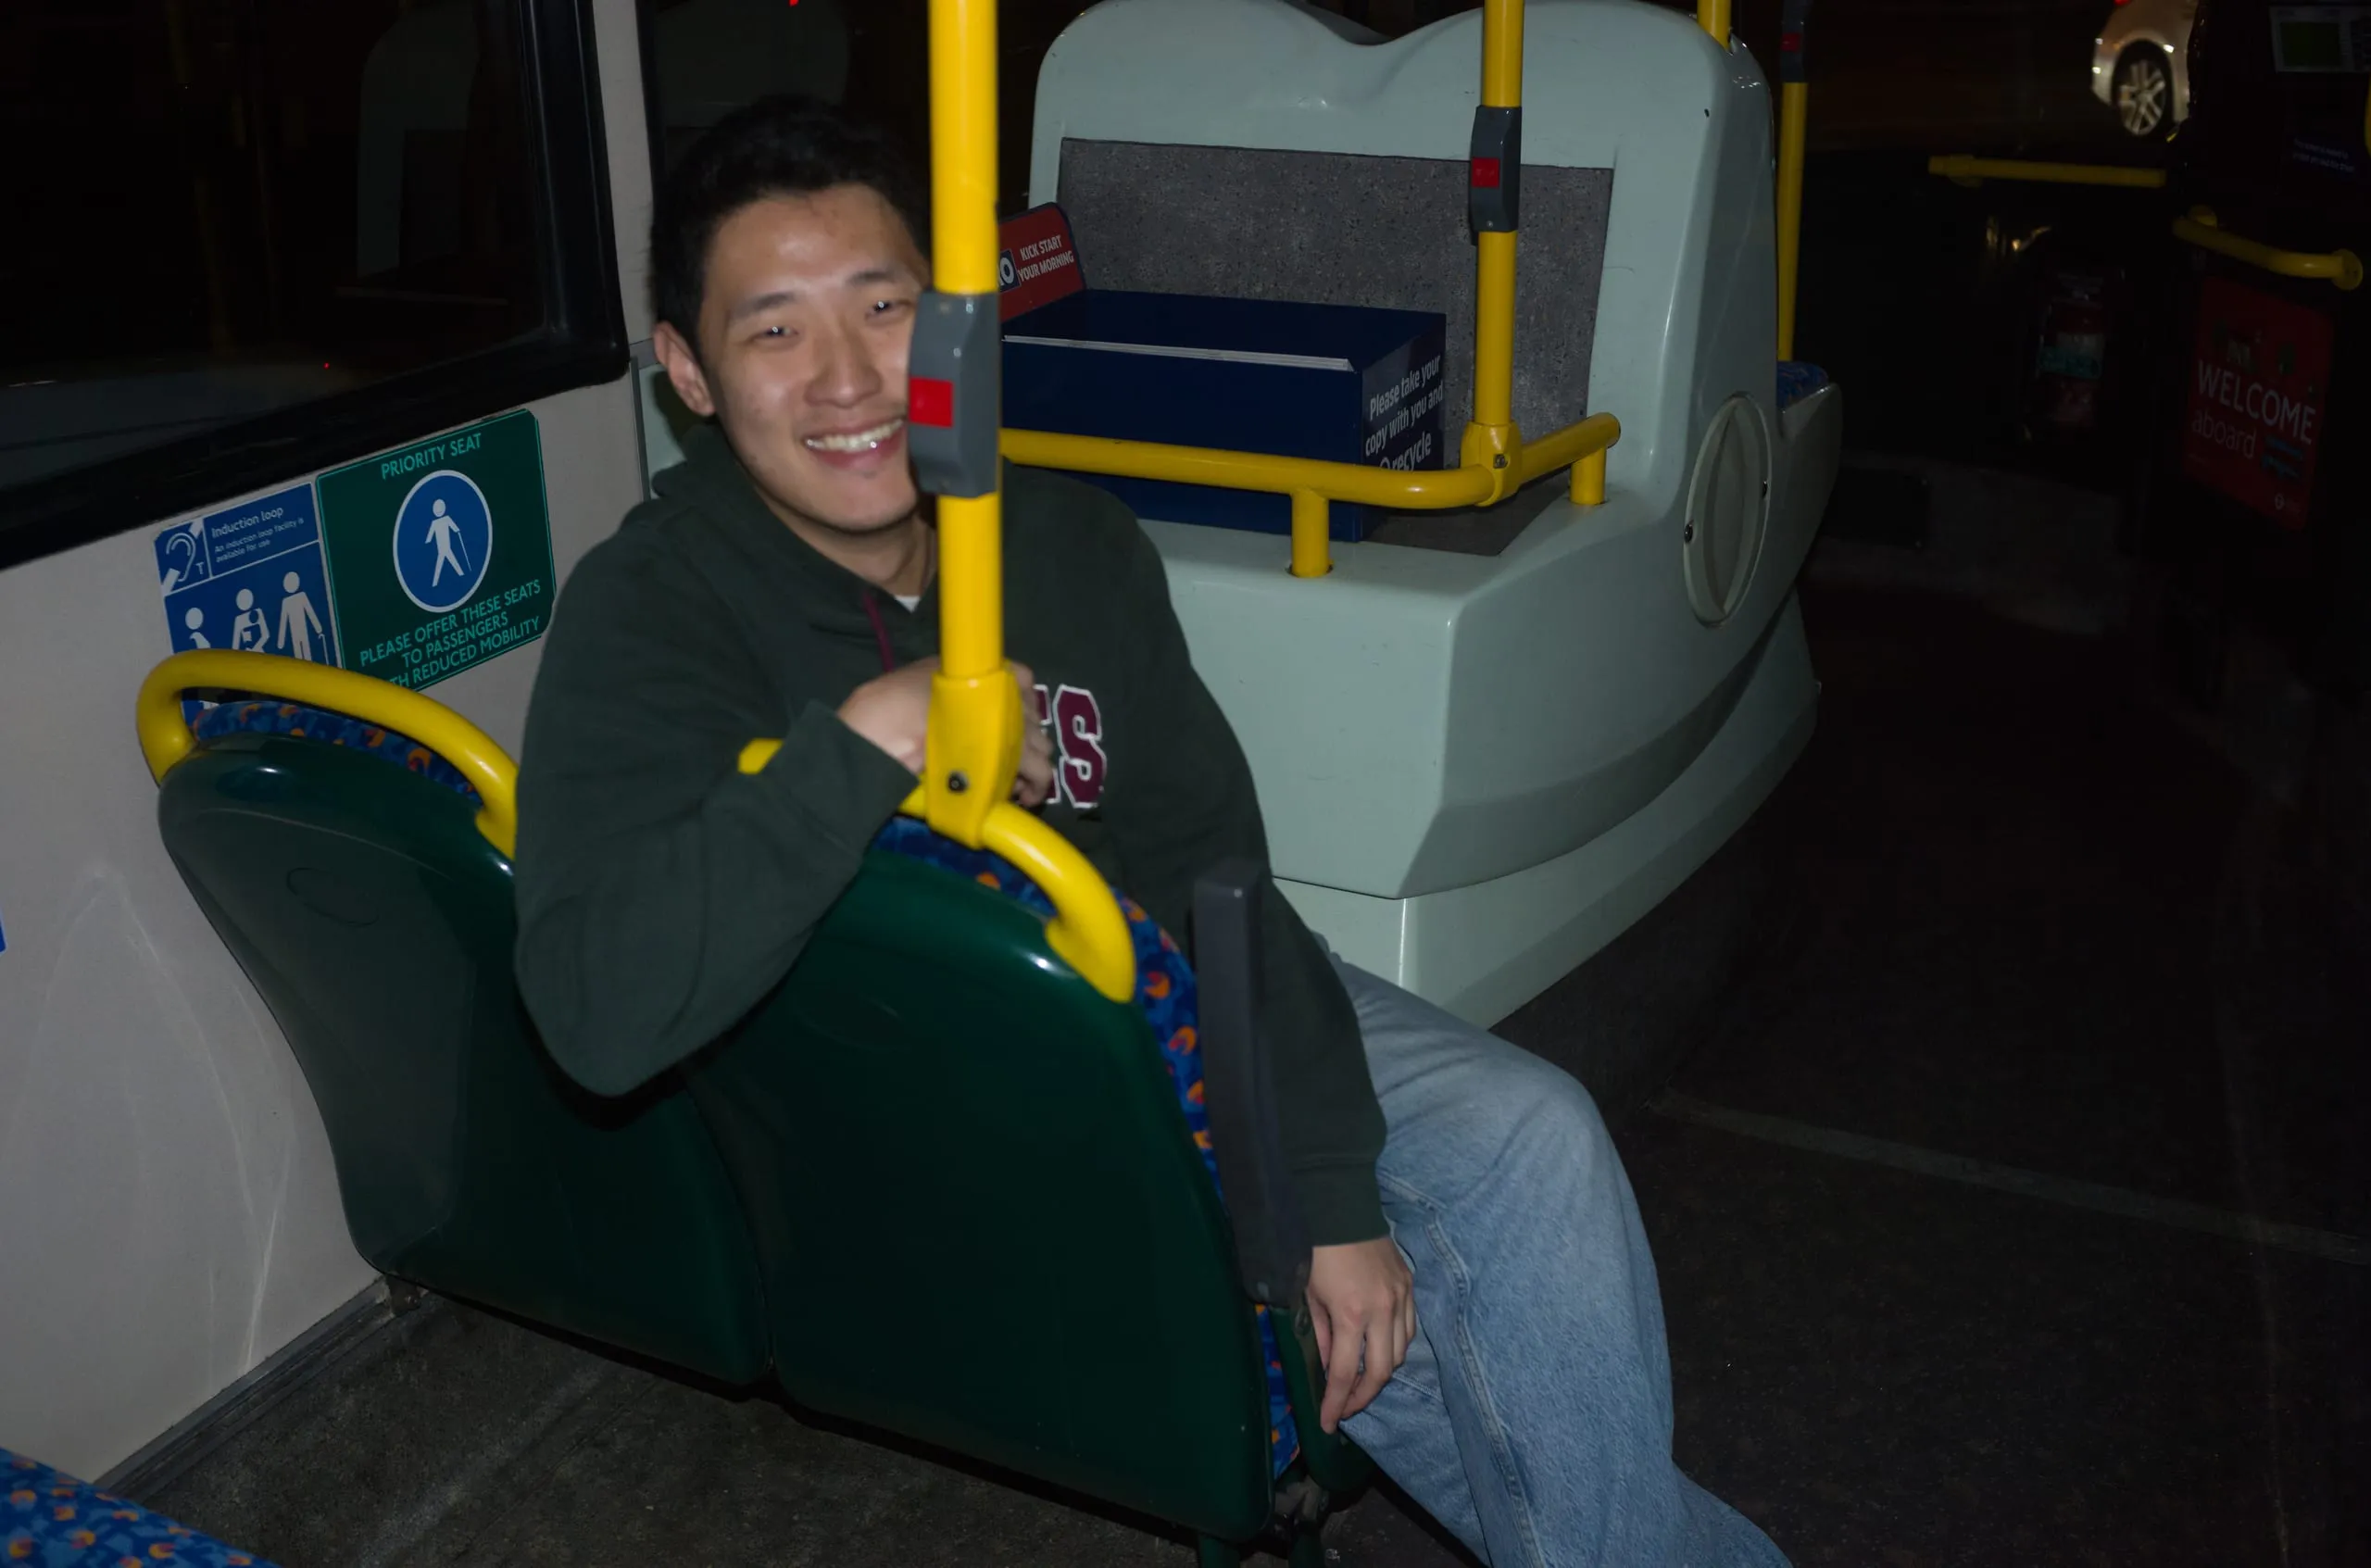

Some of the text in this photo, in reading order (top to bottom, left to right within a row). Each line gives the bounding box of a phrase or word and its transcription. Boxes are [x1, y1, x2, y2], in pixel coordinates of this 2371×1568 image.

[1017, 250, 1074, 282] YOUR MORNING
[1020, 234, 1063, 261] KICK START
[1369, 355, 1441, 421] Please take your
[2197, 358, 2317, 445] WELCOME
[1365, 381, 1443, 457] copy with you and
[2191, 408, 2257, 459] aboard
[381, 433, 482, 480] PRIORITY SEAT
[211, 507, 284, 539] Induction loop
[359, 579, 541, 667] PLEASE OFFER THESE SEATS
[401, 611, 508, 668] TO PASSENGERS
[412, 644, 477, 684] REDUCED
[480, 616, 540, 654] MOBILITY
